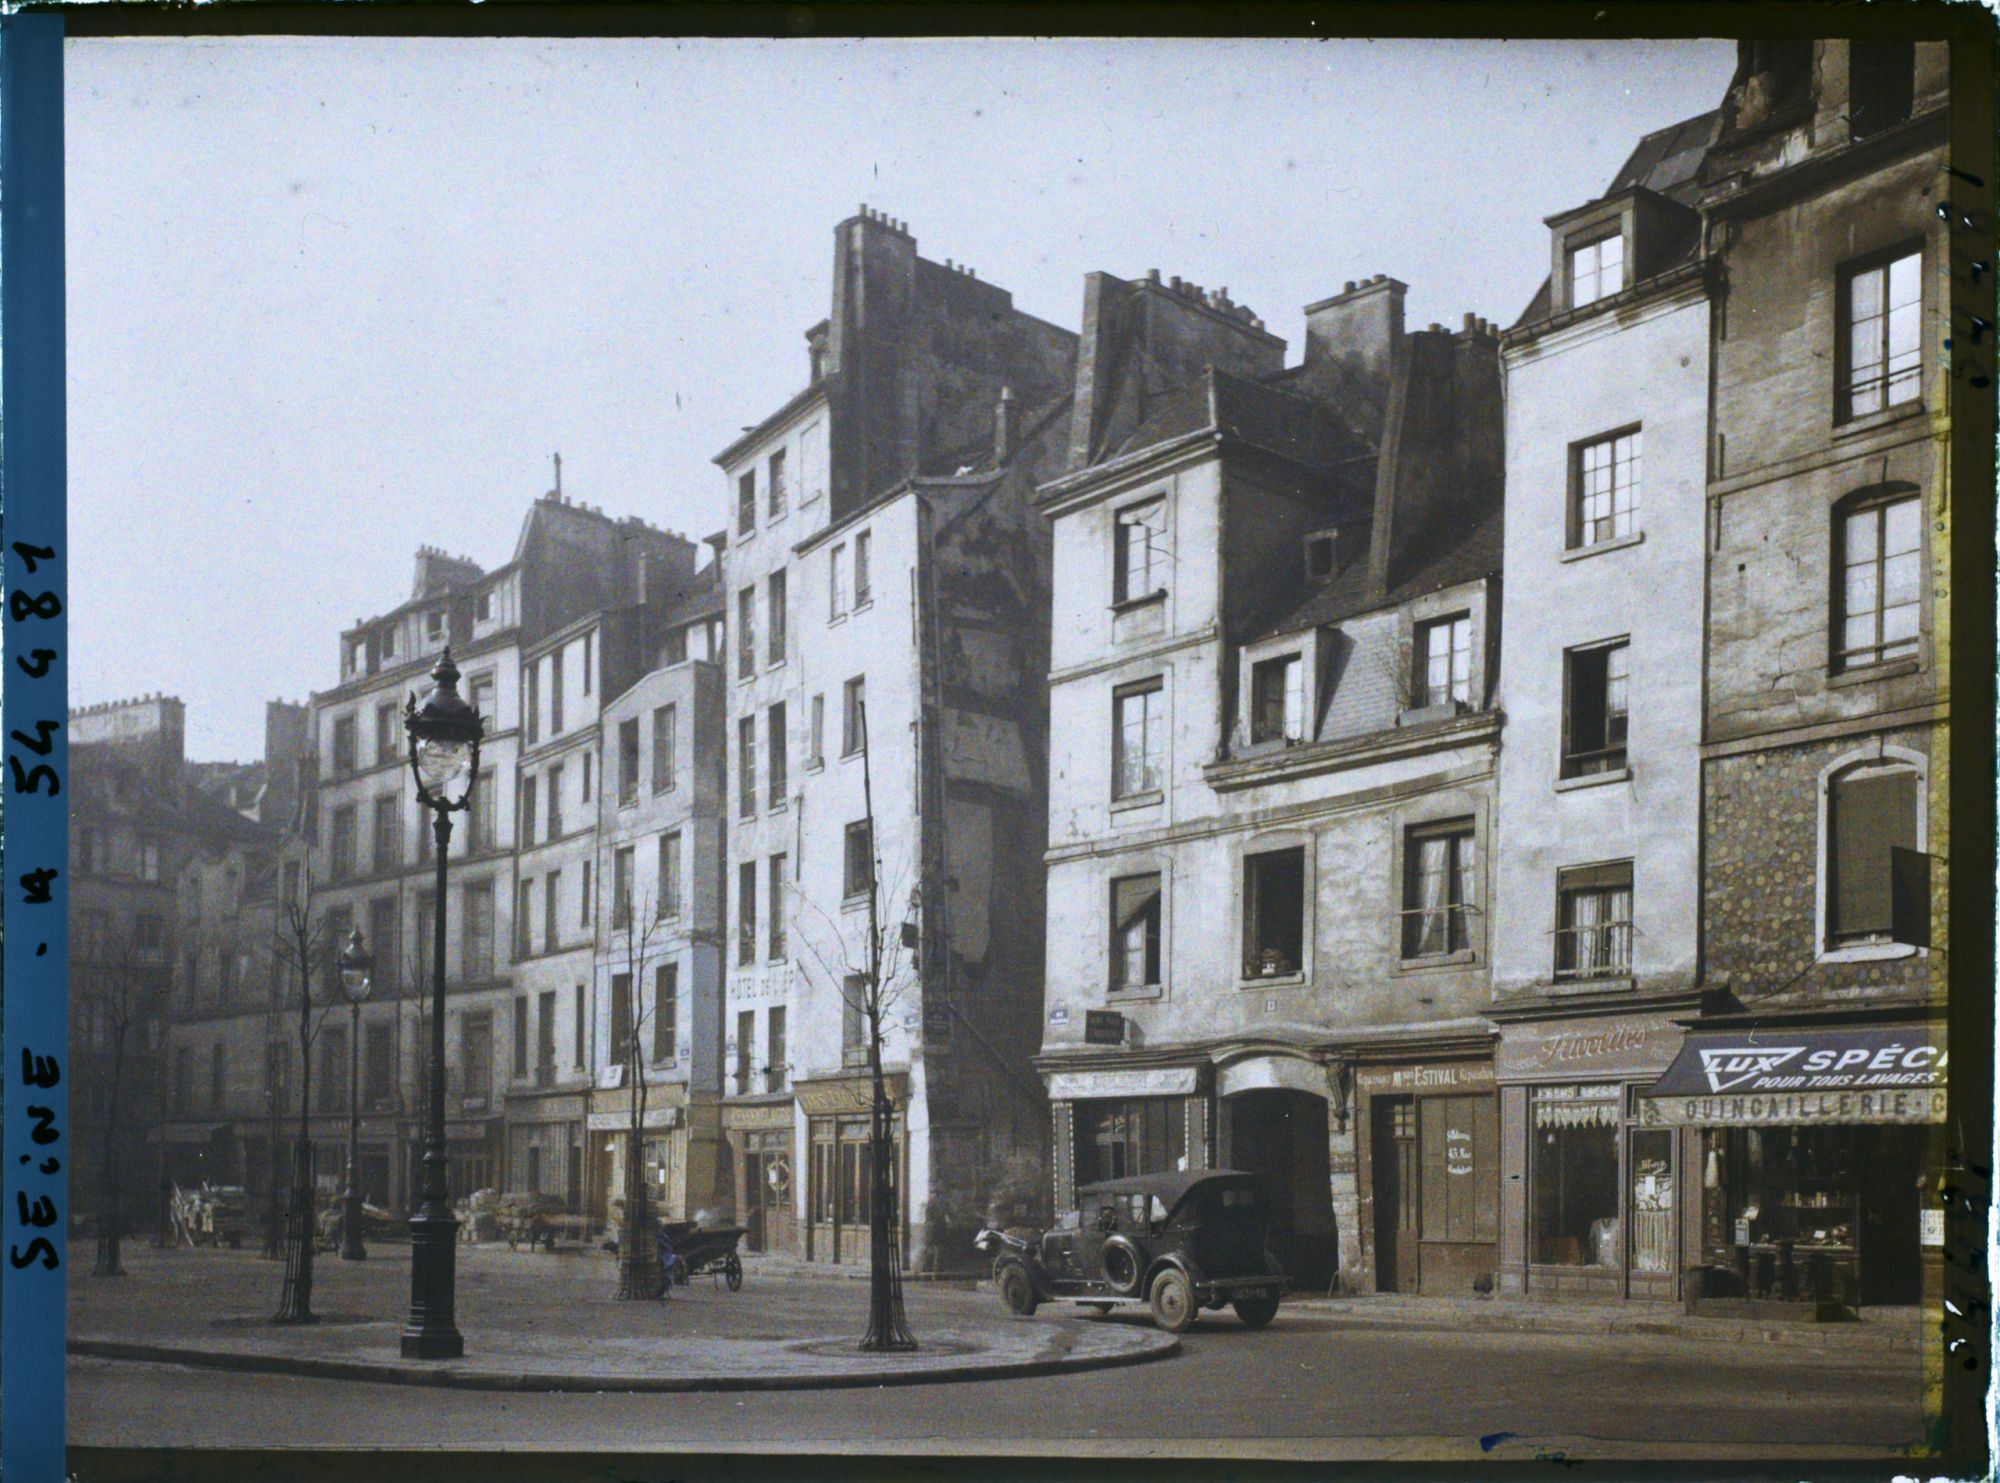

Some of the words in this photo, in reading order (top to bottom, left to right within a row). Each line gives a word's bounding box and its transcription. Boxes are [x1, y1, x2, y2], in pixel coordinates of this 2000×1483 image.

[1704, 1056, 1781, 1073] LUX
[1752, 1075, 1806, 1089] POUR
[1810, 1073, 1854, 1087] TOUS
[1853, 1072, 1940, 1086] LAVAGES
[1685, 1092, 1907, 1121] QUINCAILLERIE
